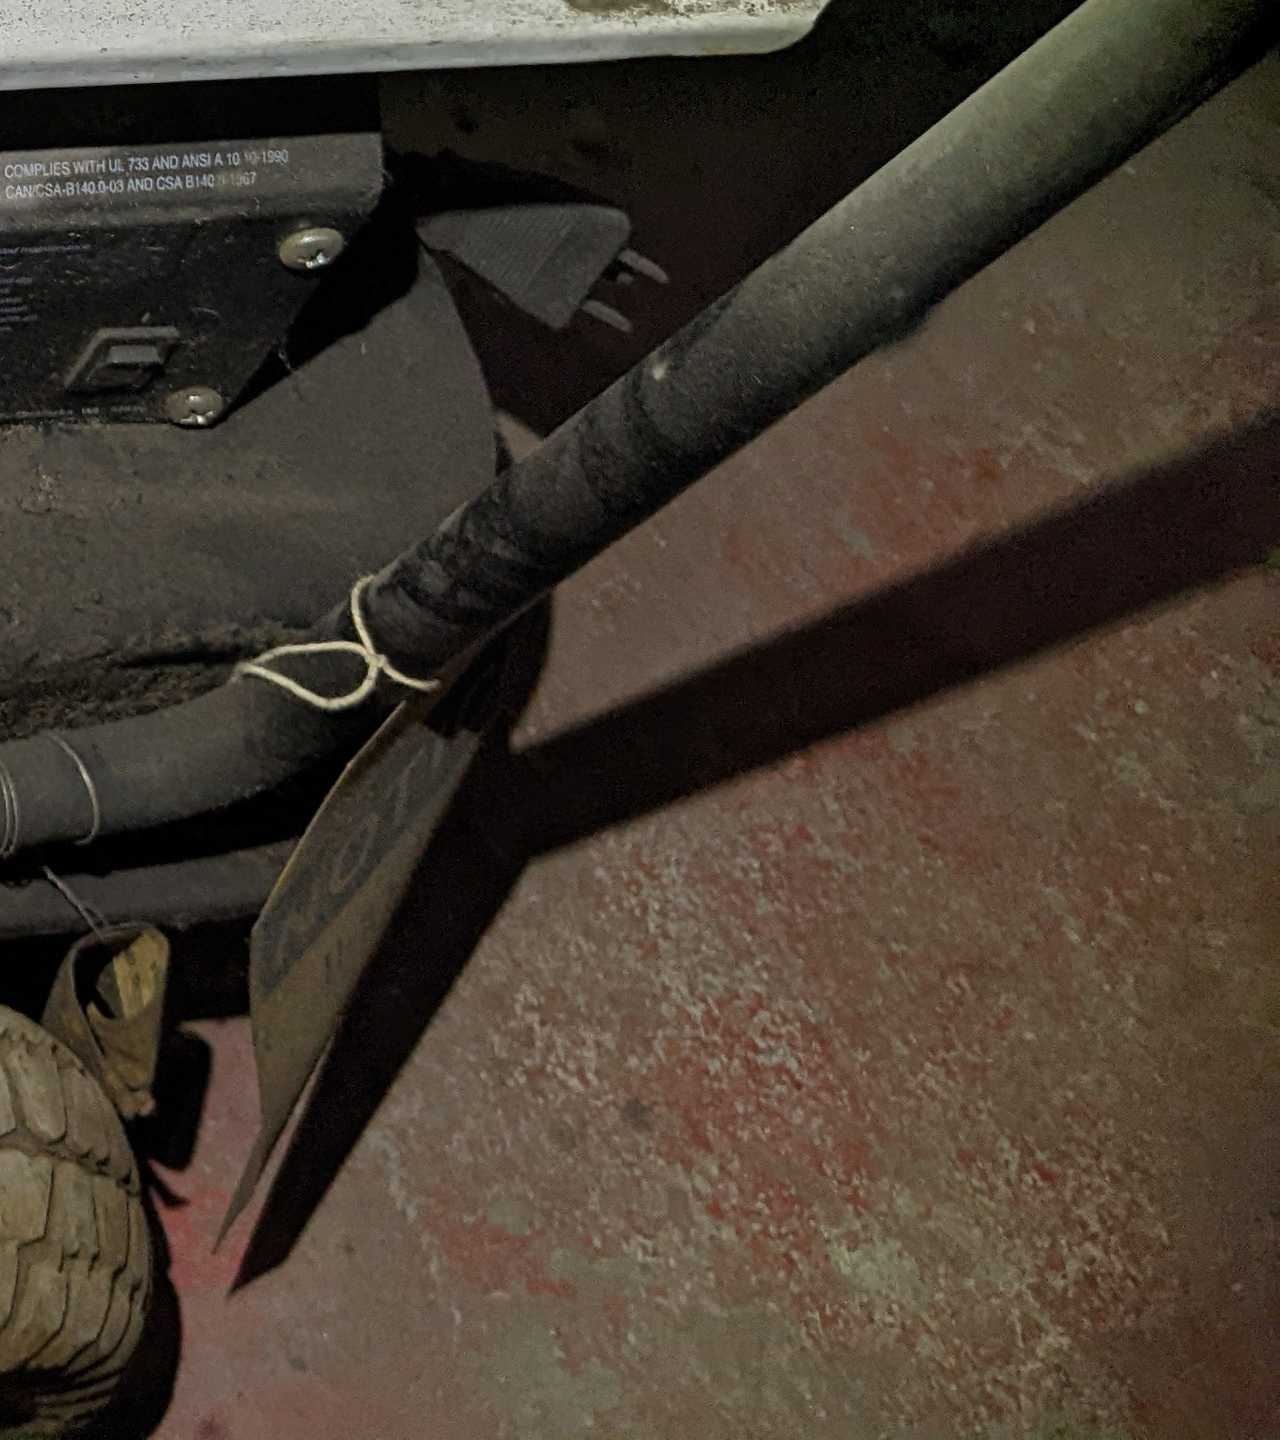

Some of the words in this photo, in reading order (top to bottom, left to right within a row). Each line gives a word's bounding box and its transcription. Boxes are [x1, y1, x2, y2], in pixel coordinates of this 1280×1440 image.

[4, 161, 72, 179] COMPLIES
[73, 159, 107, 175] WITH
[109, 158, 126, 173] UL
[127, 157, 150, 172] 733
[152, 155, 180, 171] AND
[181, 152, 211, 169] ANSI
[126, 177, 154, 192] AND
[156, 175, 184, 191] CSA
